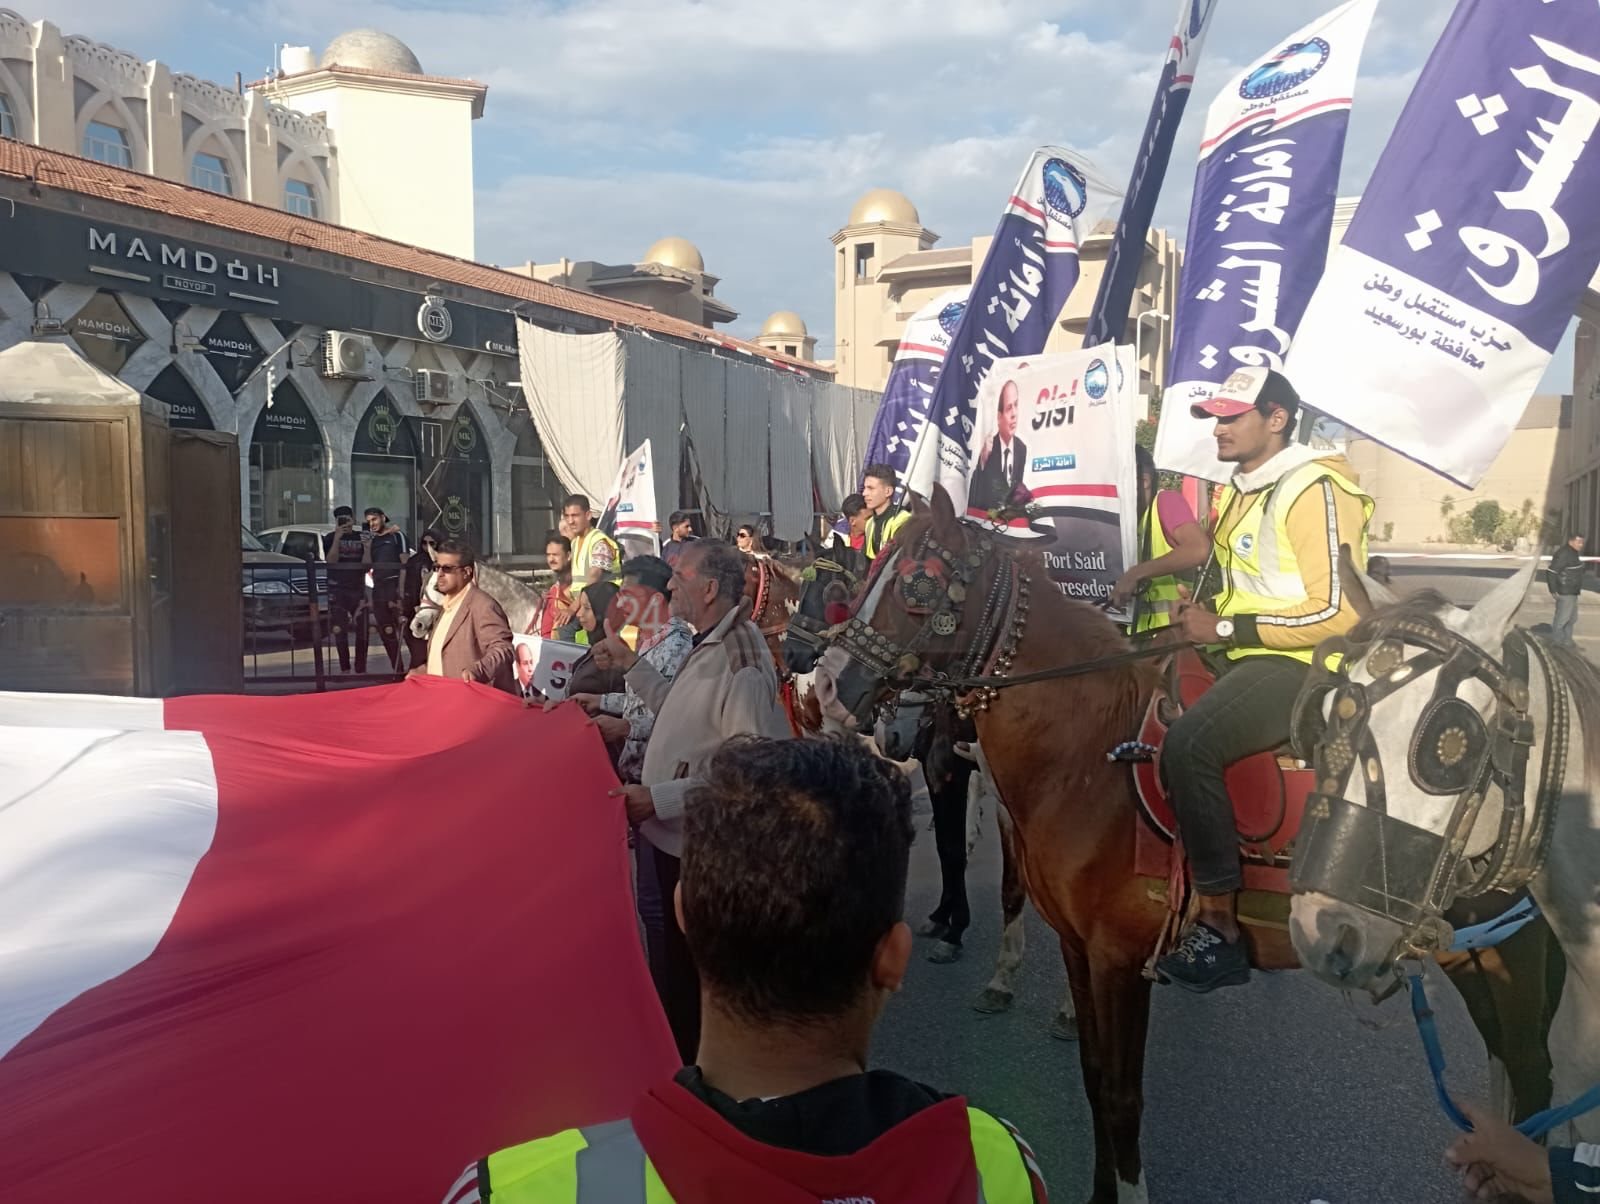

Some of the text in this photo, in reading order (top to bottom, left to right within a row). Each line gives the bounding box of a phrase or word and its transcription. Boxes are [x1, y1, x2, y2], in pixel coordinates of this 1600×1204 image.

[1363, 273, 1513, 351] حزب مستقبل وطن
[1364, 306, 1486, 370] محافظة بورسعيد
[1043, 551, 1107, 571] Port Said
